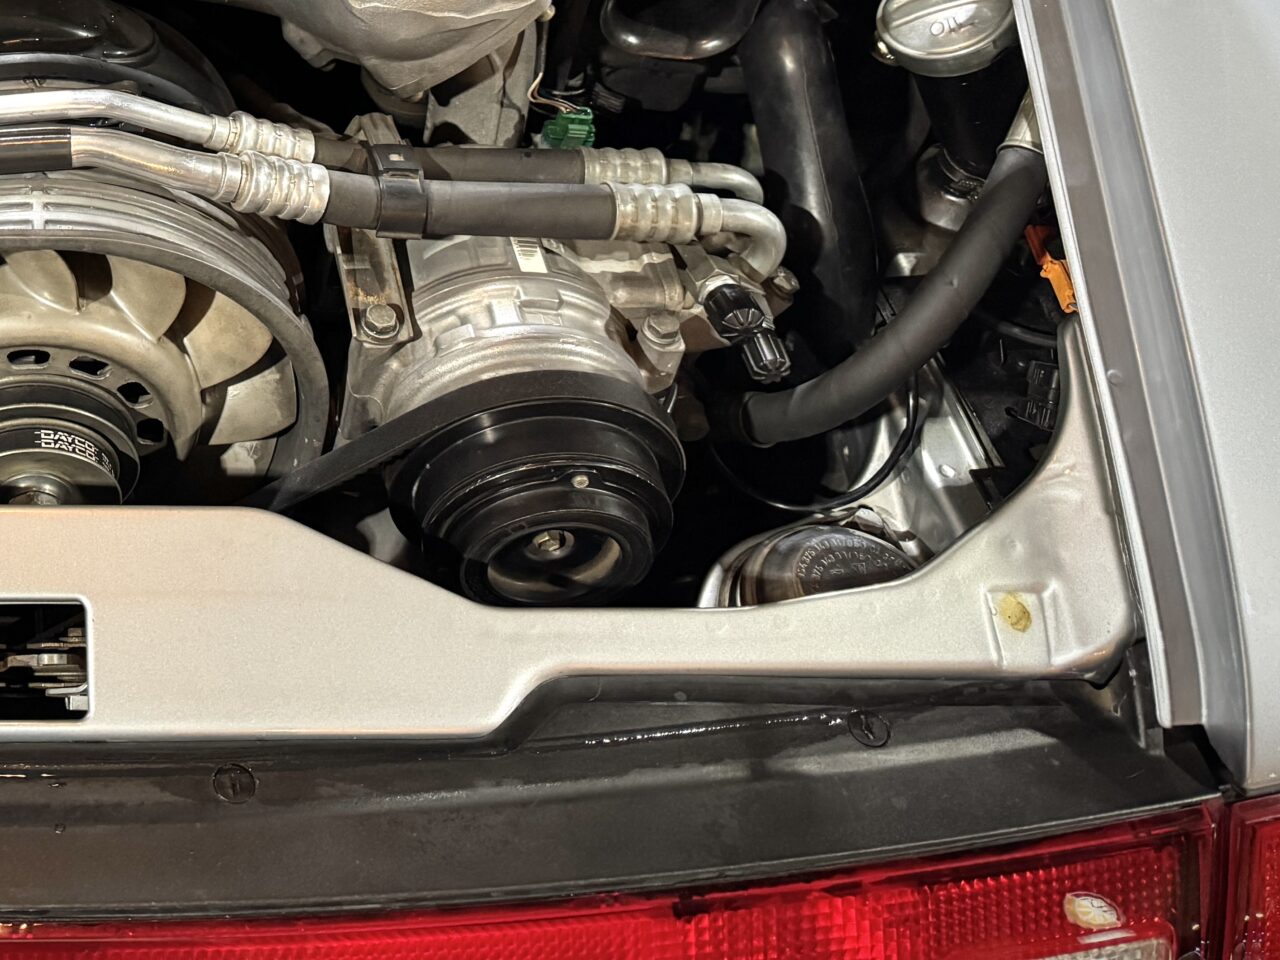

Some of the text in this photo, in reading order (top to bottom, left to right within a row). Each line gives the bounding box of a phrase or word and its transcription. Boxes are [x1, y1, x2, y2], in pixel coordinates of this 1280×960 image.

[930, 17, 975, 38] OIL
[40, 429, 96, 452] DAYCO
[41, 439, 97, 462] DAYCO
